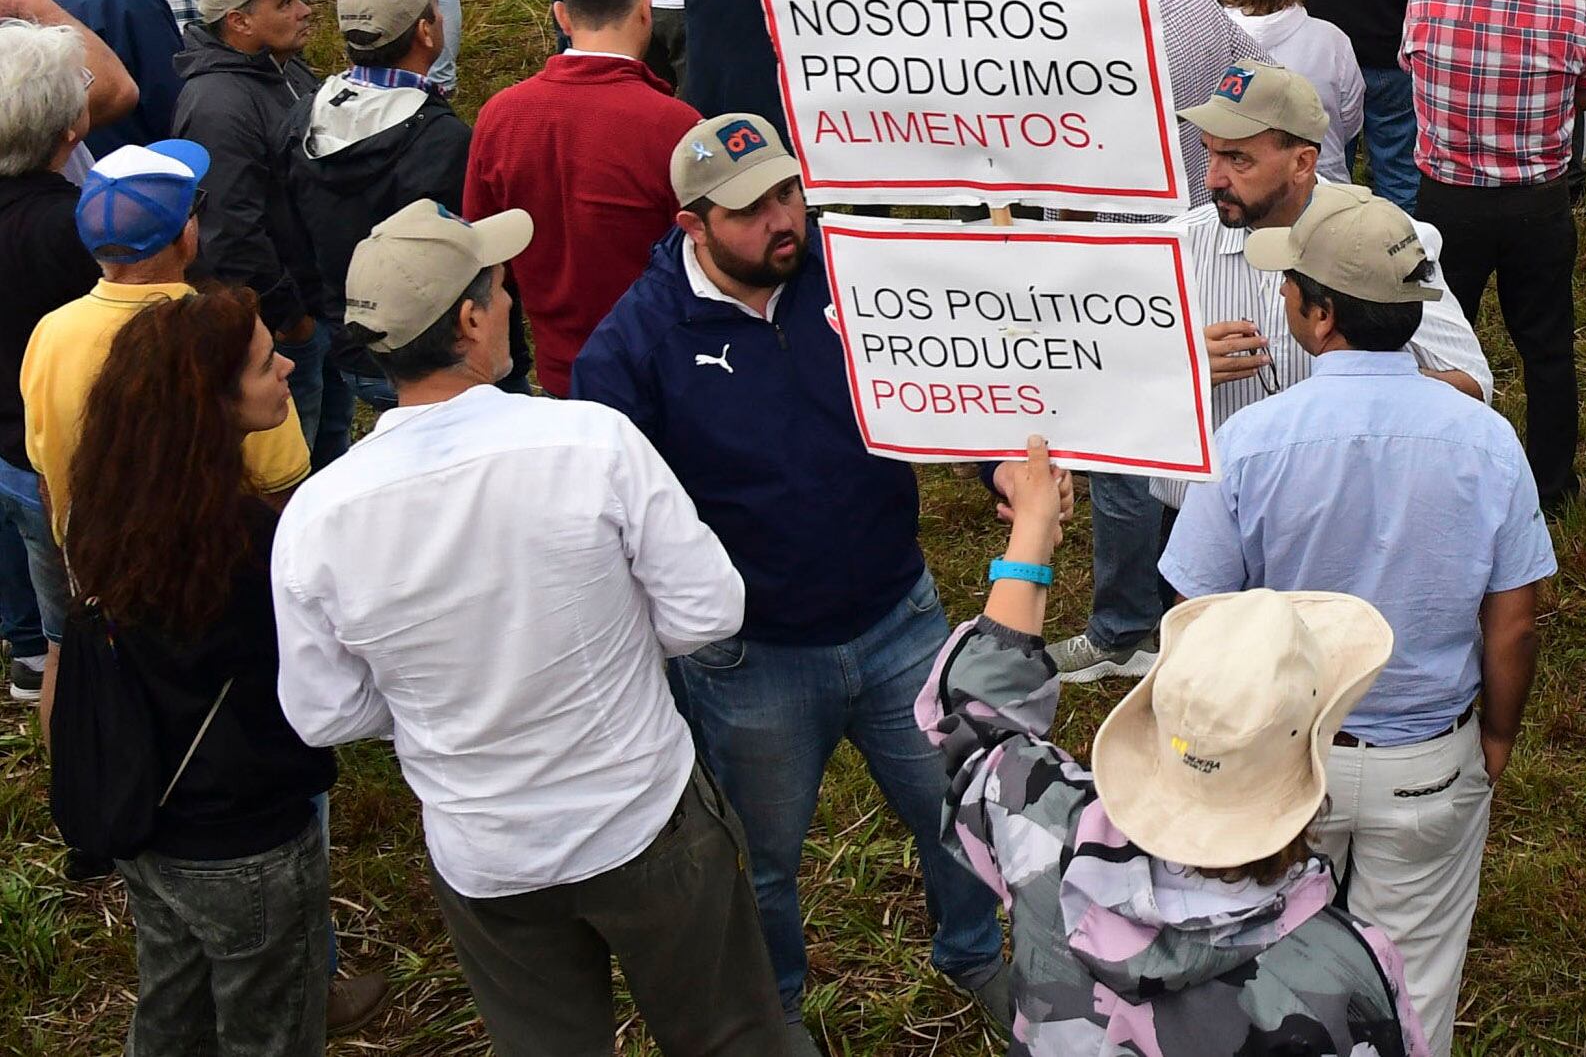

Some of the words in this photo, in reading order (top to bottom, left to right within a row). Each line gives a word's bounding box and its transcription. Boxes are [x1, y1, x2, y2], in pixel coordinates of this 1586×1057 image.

[801, 54, 1139, 97] PRODUCIMOS
[815, 110, 1104, 150] ALIMENTOS.
[851, 285, 934, 321] LOS
[945, 285, 1177, 329] POLÍTICOS
[861, 333, 1104, 371] PRODUCEN
